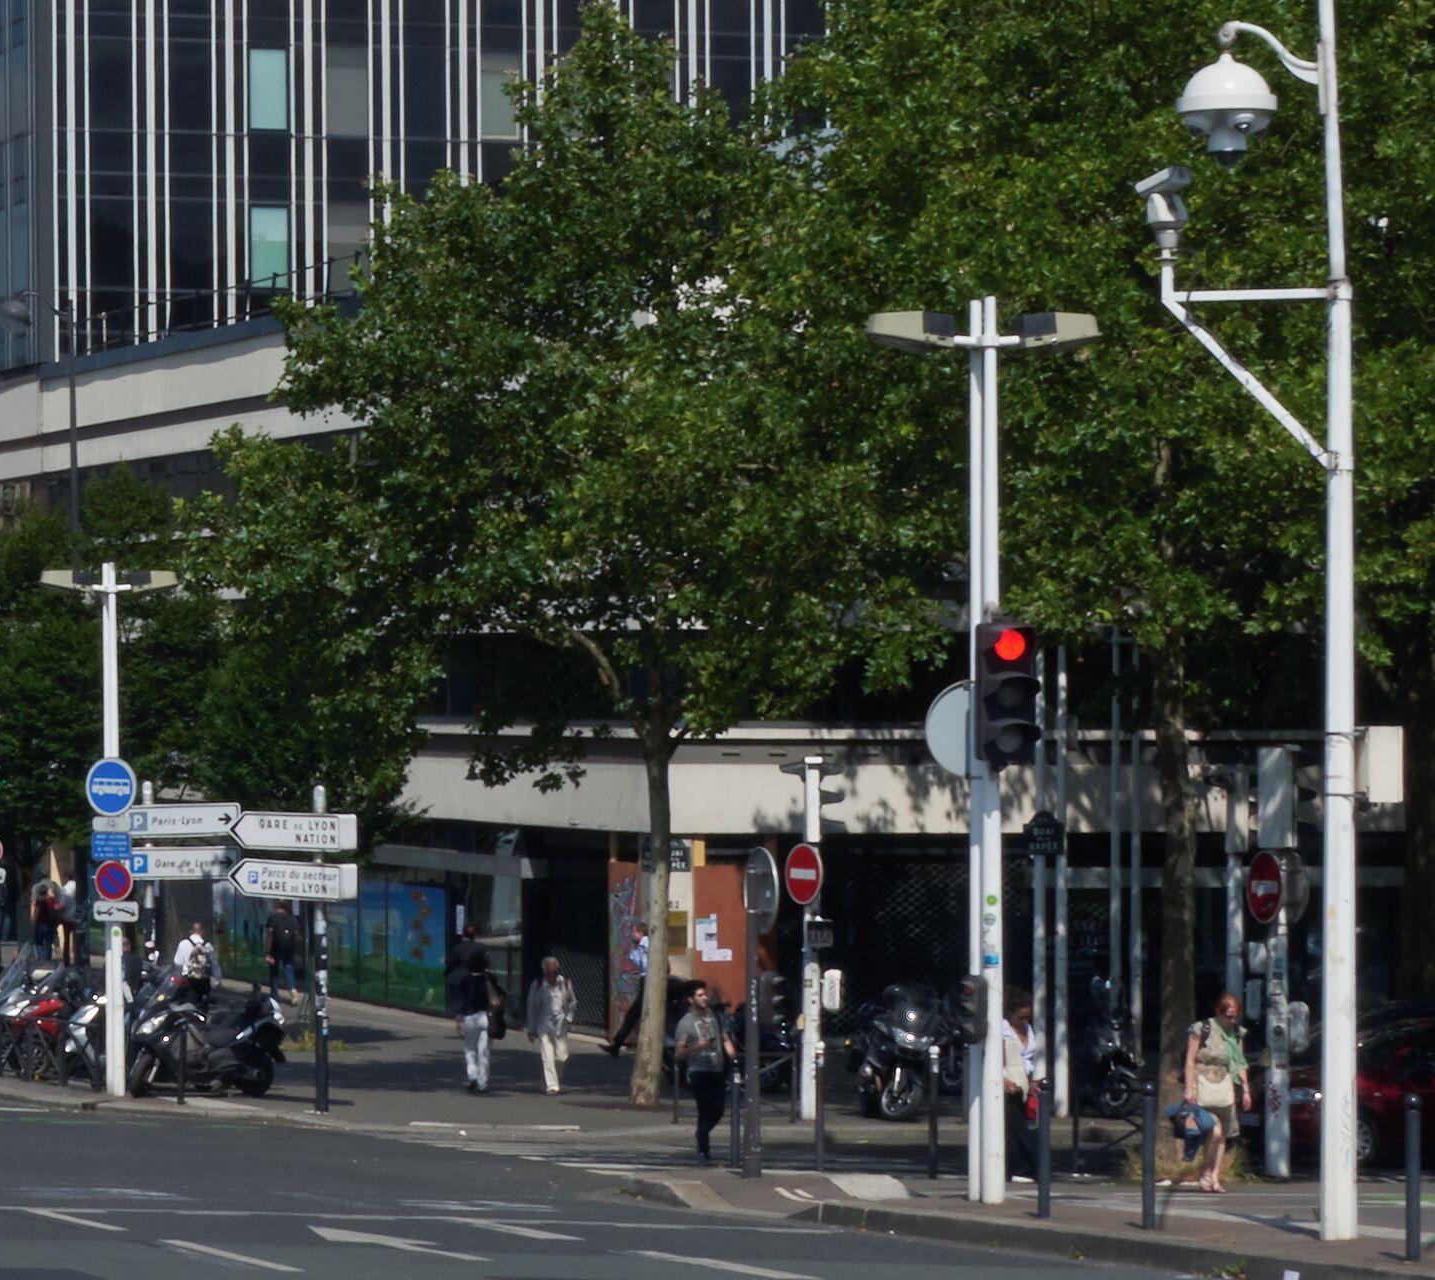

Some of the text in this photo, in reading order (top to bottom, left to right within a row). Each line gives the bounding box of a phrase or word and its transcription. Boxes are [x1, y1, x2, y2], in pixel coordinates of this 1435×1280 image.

[151, 816, 204, 827] Paris-Lyon
[258, 819, 288, 830] GARE
[308, 821, 337, 831] LYON
[295, 833, 337, 844] NATION
[154, 859, 176, 869] Gare
[178, 858, 192, 868] de
[261, 867, 286, 878] Parcs
[289, 869, 300, 880] du
[303, 870, 338, 882] secteur
[261, 880, 286, 892] GARE
[302, 883, 328, 894] LYON
